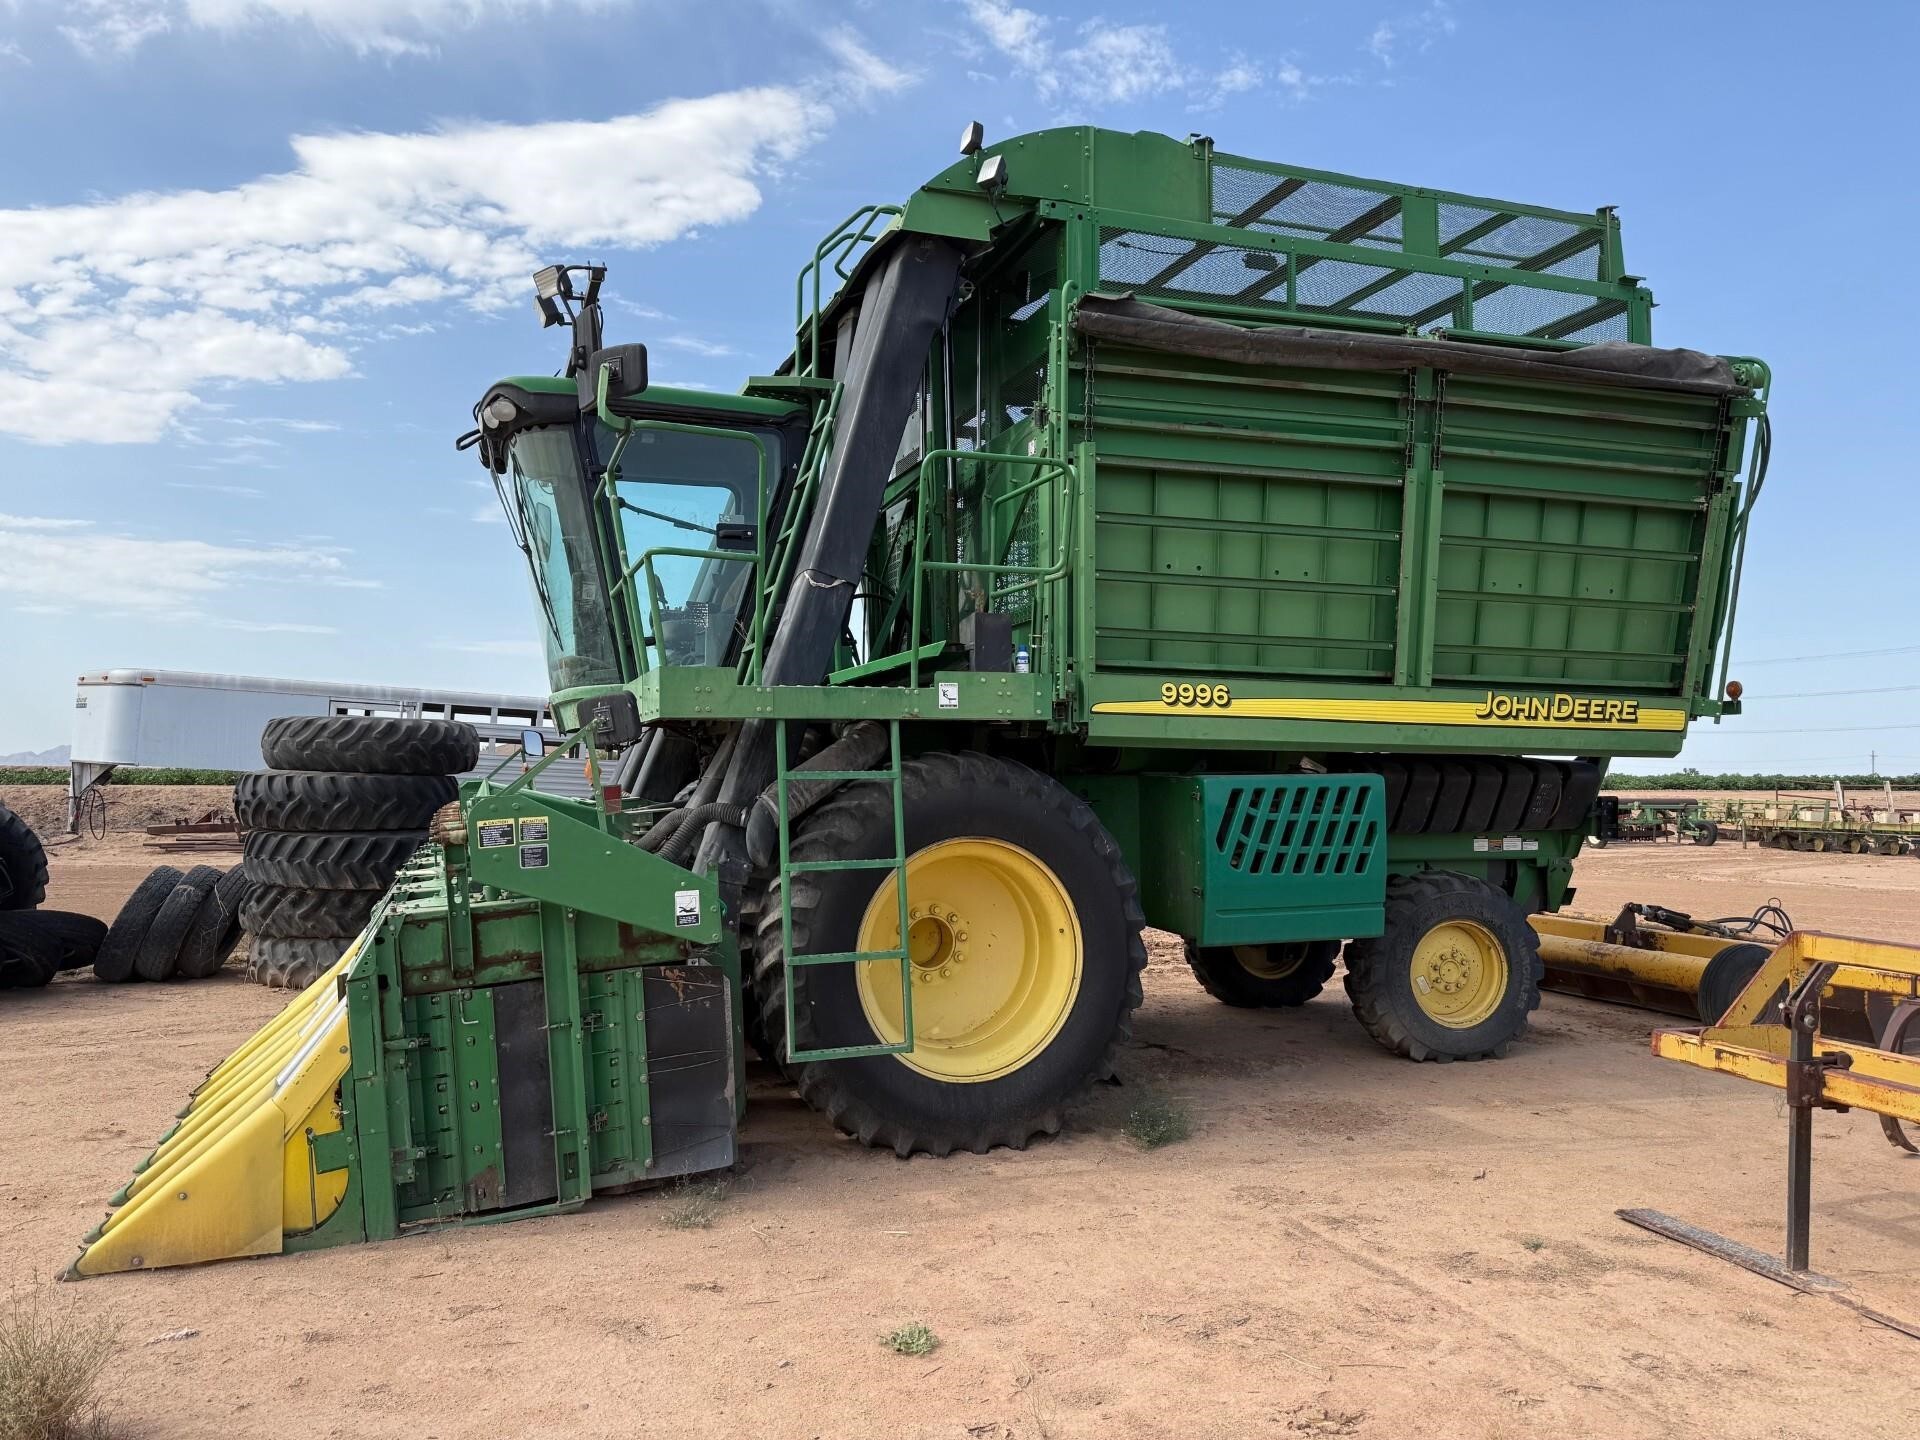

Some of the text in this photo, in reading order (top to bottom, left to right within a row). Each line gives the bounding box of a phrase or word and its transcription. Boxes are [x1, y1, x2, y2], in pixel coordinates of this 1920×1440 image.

[1161, 682, 1231, 707] 9996
[1476, 690, 1638, 723] JOHN DEERE
